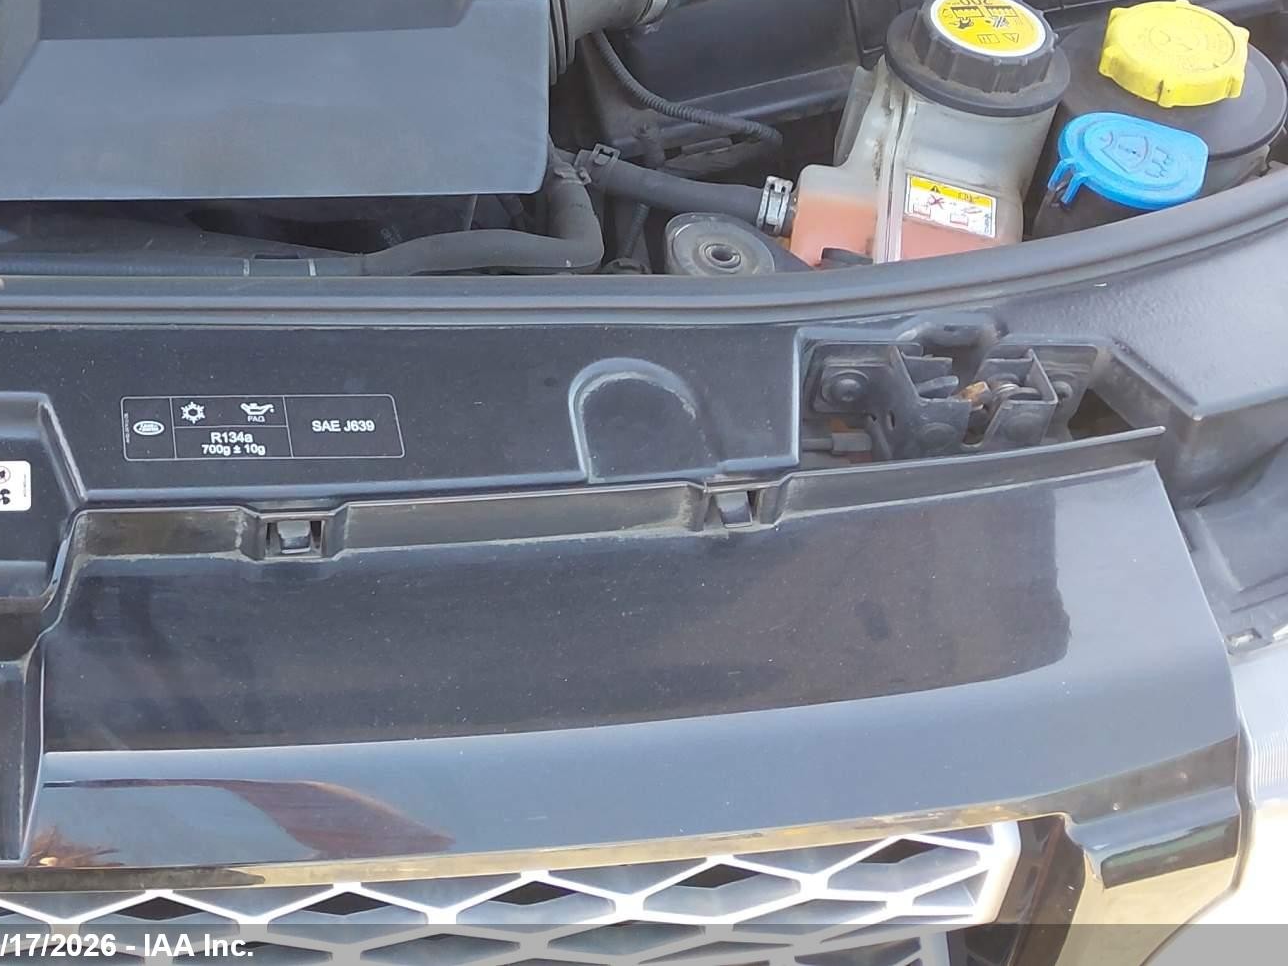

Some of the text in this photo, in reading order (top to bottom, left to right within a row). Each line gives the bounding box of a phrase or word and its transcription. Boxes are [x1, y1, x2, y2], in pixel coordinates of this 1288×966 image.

[312, 420, 375, 432] SAE J639
[211, 432, 253, 444] R134a
[202, 444, 231, 456] 700g
[244, 444, 266, 456] 10g
